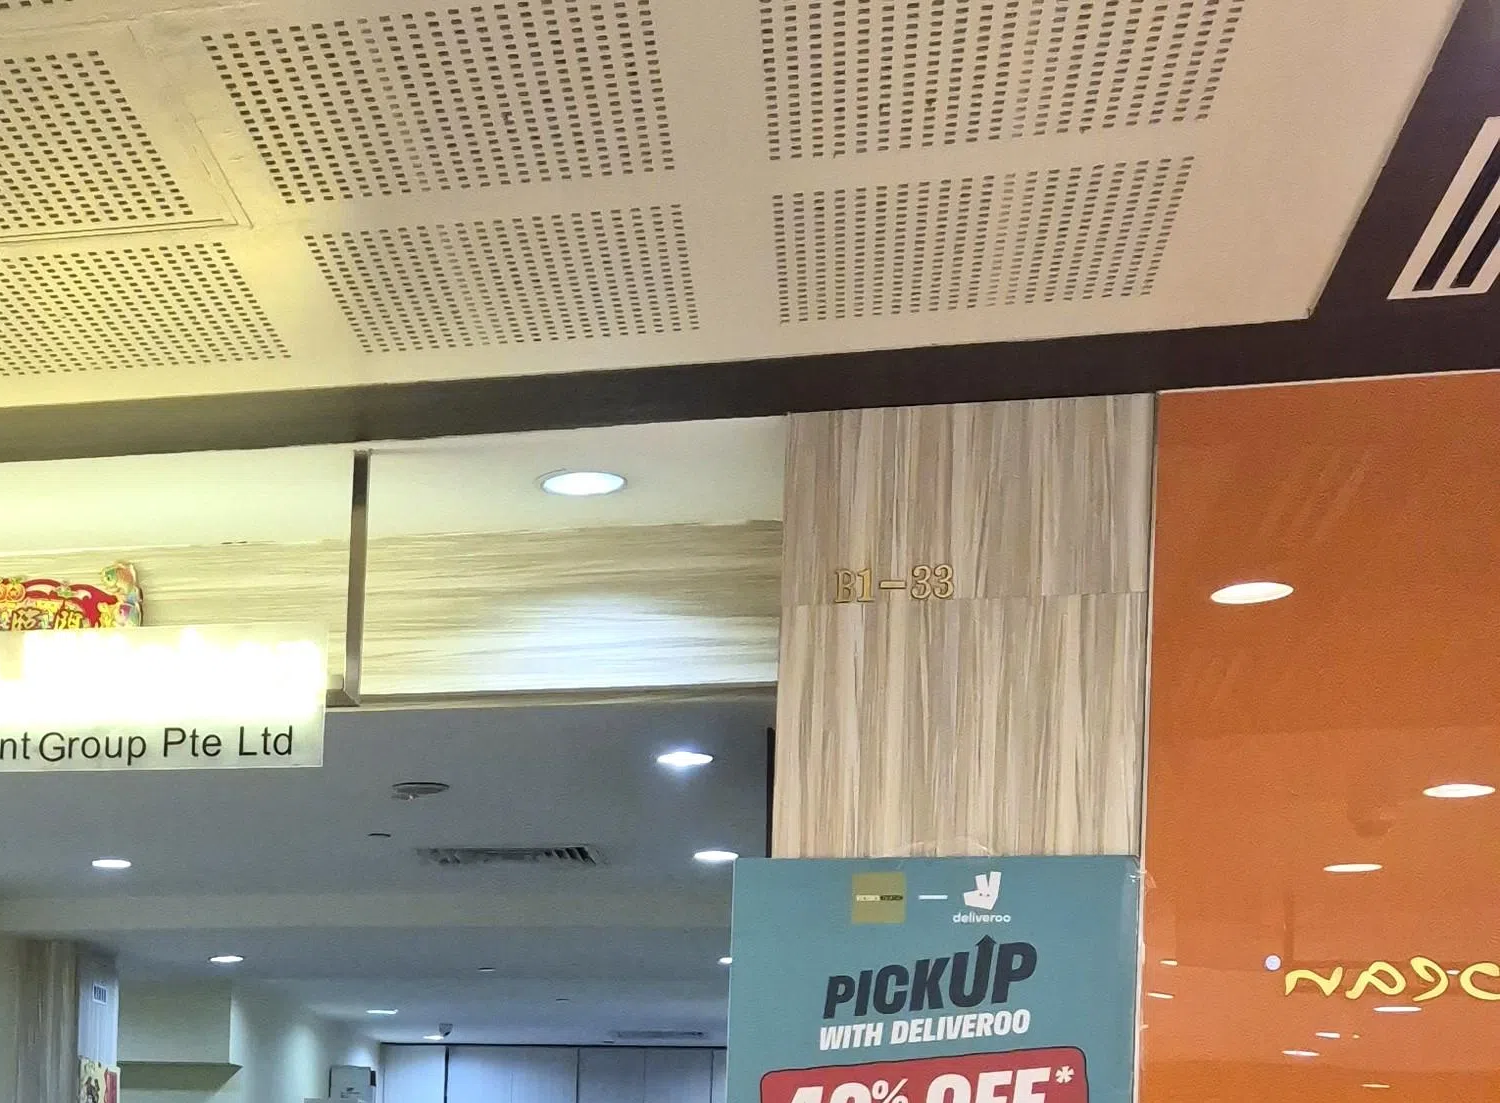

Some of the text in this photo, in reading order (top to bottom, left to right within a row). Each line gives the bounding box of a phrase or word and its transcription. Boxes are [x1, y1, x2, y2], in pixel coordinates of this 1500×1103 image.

[834, 563, 955, 605] B1-33
[38, 731, 147, 765] Group
[162, 726, 223, 757] Pte
[238, 724, 294, 755] Ltd
[952, 911, 1012, 924] deliveroo
[822, 934, 1038, 1019] PICKUP
[819, 1007, 1032, 1051] WITH DELIVEROO
